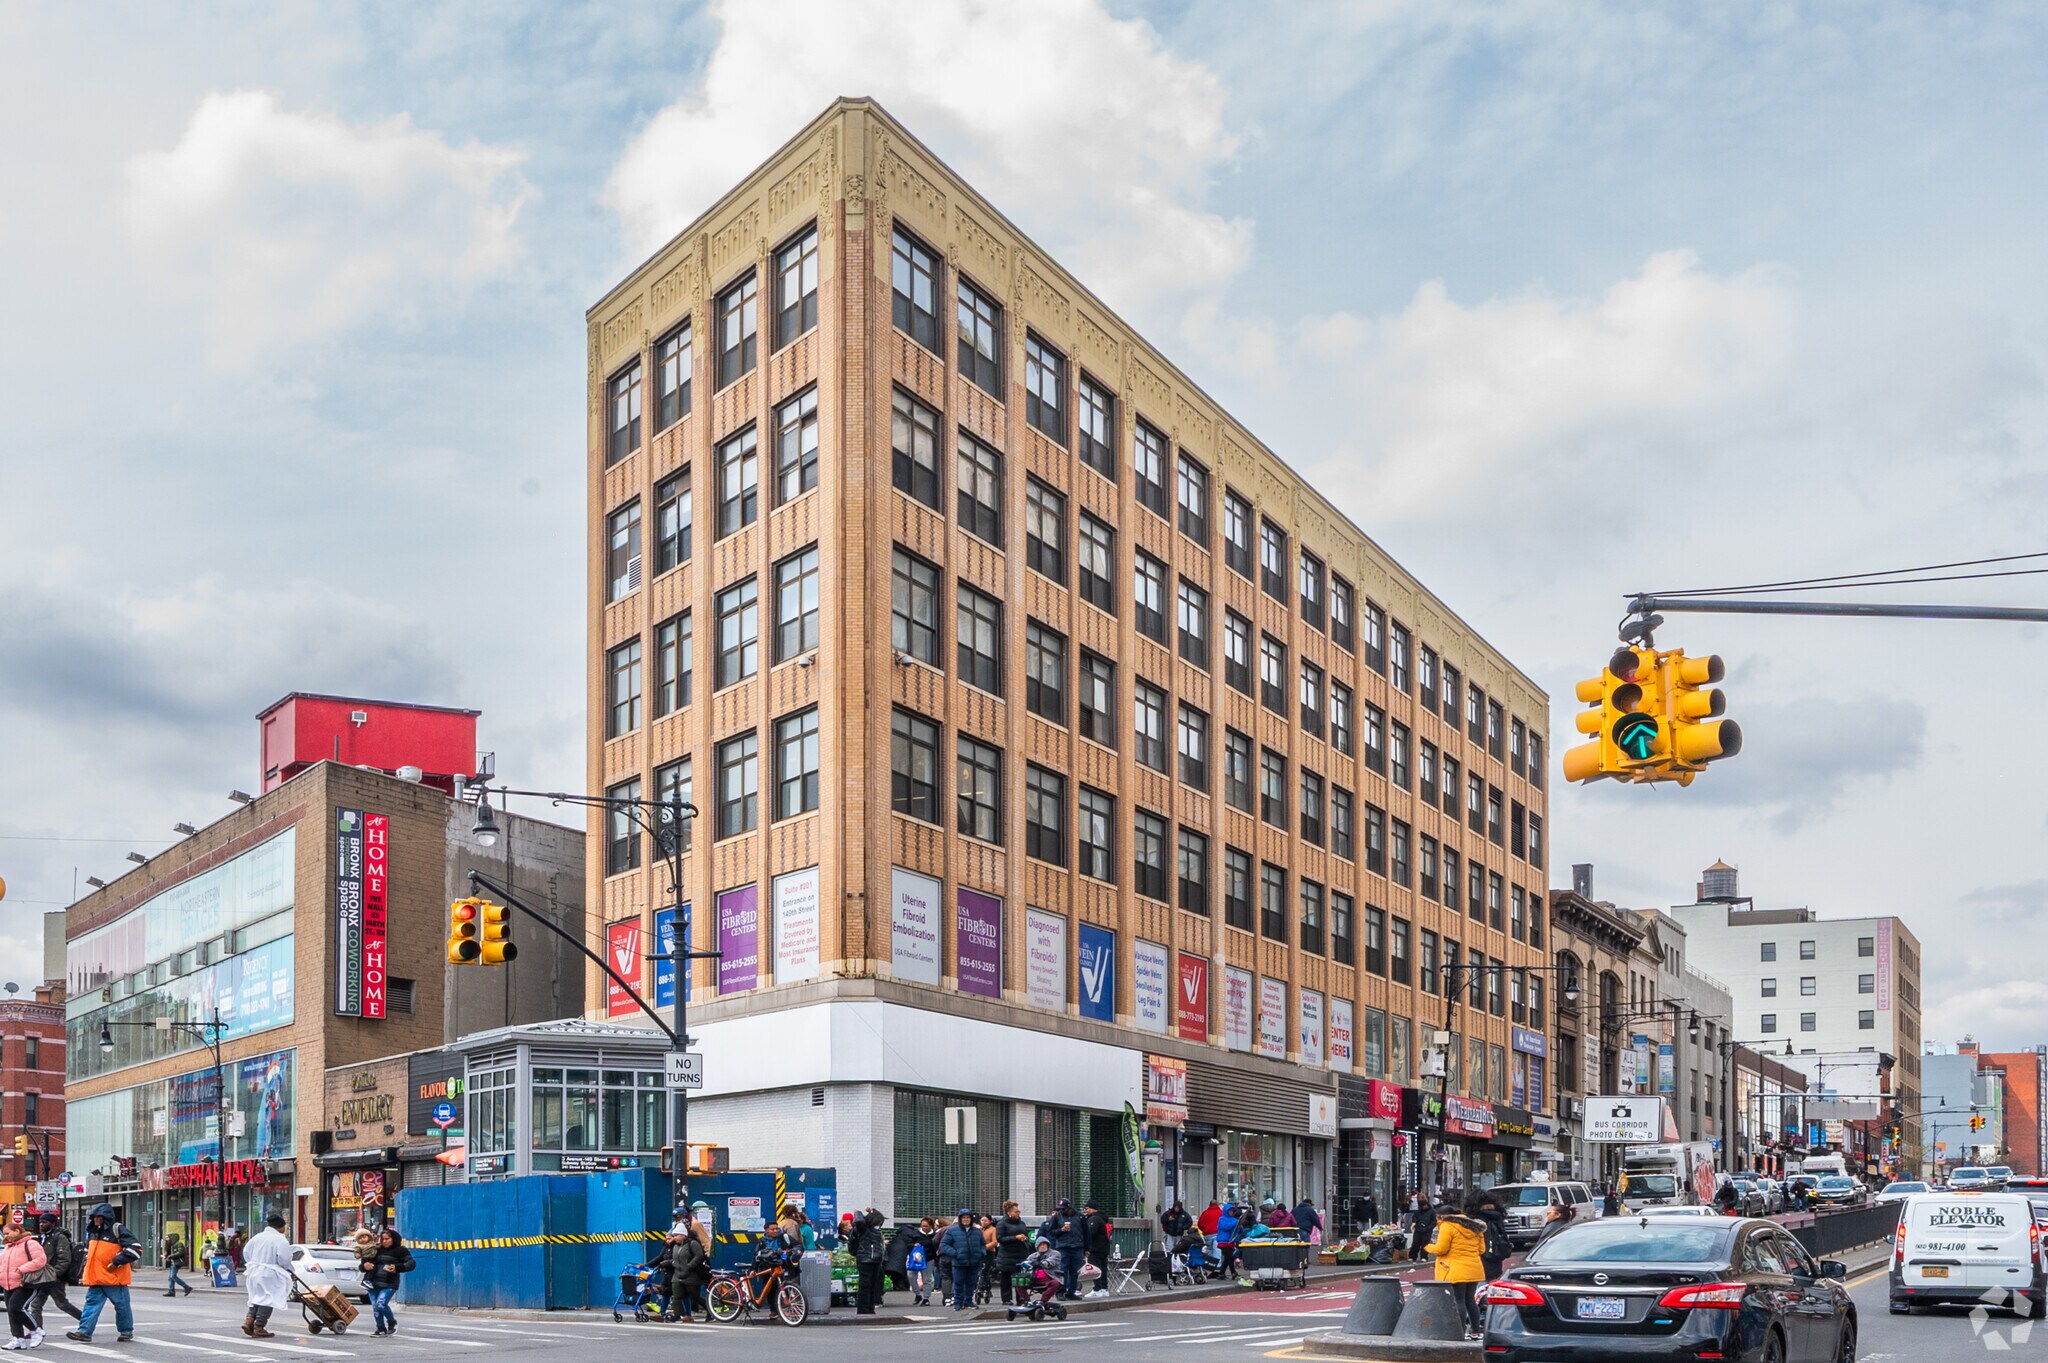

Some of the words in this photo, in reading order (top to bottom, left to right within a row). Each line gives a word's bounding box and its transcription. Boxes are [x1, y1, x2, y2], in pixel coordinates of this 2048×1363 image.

[350, 838, 360, 878] BRONX
[367, 829, 384, 892] HOME
[785, 885, 798, 894] Suite
[800, 881, 812, 891] #201
[338, 880, 348, 918] space
[348, 881, 359, 927] BRONX
[783, 897, 806, 908] Entrance
[902, 893, 926, 909] Uterine
[722, 908, 732, 917] USA
[783, 909, 797, 918] 149th
[798, 905, 815, 914] Street
[903, 909, 926, 924] Fibroid
[958, 906, 969, 916] USA
[722, 910, 756, 930] FIBROID
[784, 918, 813, 930] Treatments
[1028, 917, 1060, 934] Diagnosed
[731, 923, 756, 936] CENTERS
[893, 922, 935, 942] Embolization
[958, 917, 996, 938] FIBROID
[784, 930, 805, 939] Covered
[969, 933, 996, 948] CENTERS
[366, 940, 384, 950] At
[781, 938, 804, 949] Medicare
[1038, 936, 1050, 947] with
[778, 950, 791, 958] Most
[792, 945, 818, 956] Insurance
[904, 950, 918, 960] Fibroid
[919, 953, 934, 963] Centers
[1031, 948, 1057, 964] Fibroids?
[1079, 948, 1095, 960] VEIN
[722, 955, 757, 971] 855-615-2555
[791, 958, 806, 966] Plans
[960, 956, 996, 972] 855-615-2555
[1135, 952, 1152, 963] Varicose
[1153, 956, 1164, 966] Veins
[348, 929, 358, 1012] COWORKING
[1136, 966, 1150, 976] Spider
[1151, 969, 1162, 980] Veins
[366, 952, 382, 1015] HOME
[1136, 980, 1152, 991] Swollen
[1153, 986, 1163, 996] Legs
[1226, 975, 1247, 988] Diagnosed
[1138, 994, 1146, 1006] Leg
[1147, 996, 1157, 1007] Pain
[1263, 1000, 1275, 1009] Medicare
[1143, 1008, 1156, 1020] Ulcers
[1303, 1003, 1316, 1012] Walk-ins
[1303, 1010, 1317, 1020] Welcome
[1332, 1027, 1350, 1042] ENTER
[676, 1059, 692, 1069] NO
[1149, 1054, 1160, 1066] CELL
[1160, 1056, 1174, 1068] PHONE
[1174, 1059, 1186, 1070] STORE
[1624, 1051, 1633, 1064] ALL
[1621, 1065, 1635, 1076] TRAFFIC
[667, 1073, 700, 1082] TURNS
[420, 1082, 446, 1098] FLAVOR
[1311, 1122, 1334, 1134] COSMETICS
[1499, 1120, 1510, 1134] Army
[1510, 1122, 1521, 1133] Career
[39, 1193, 55, 1202] 25
[1939, 1207, 1996, 1215] NOBLE
[1930, 1215, 2006, 1226] ELEVATOR
[1579, 1303, 1623, 1314] KMV-2260
